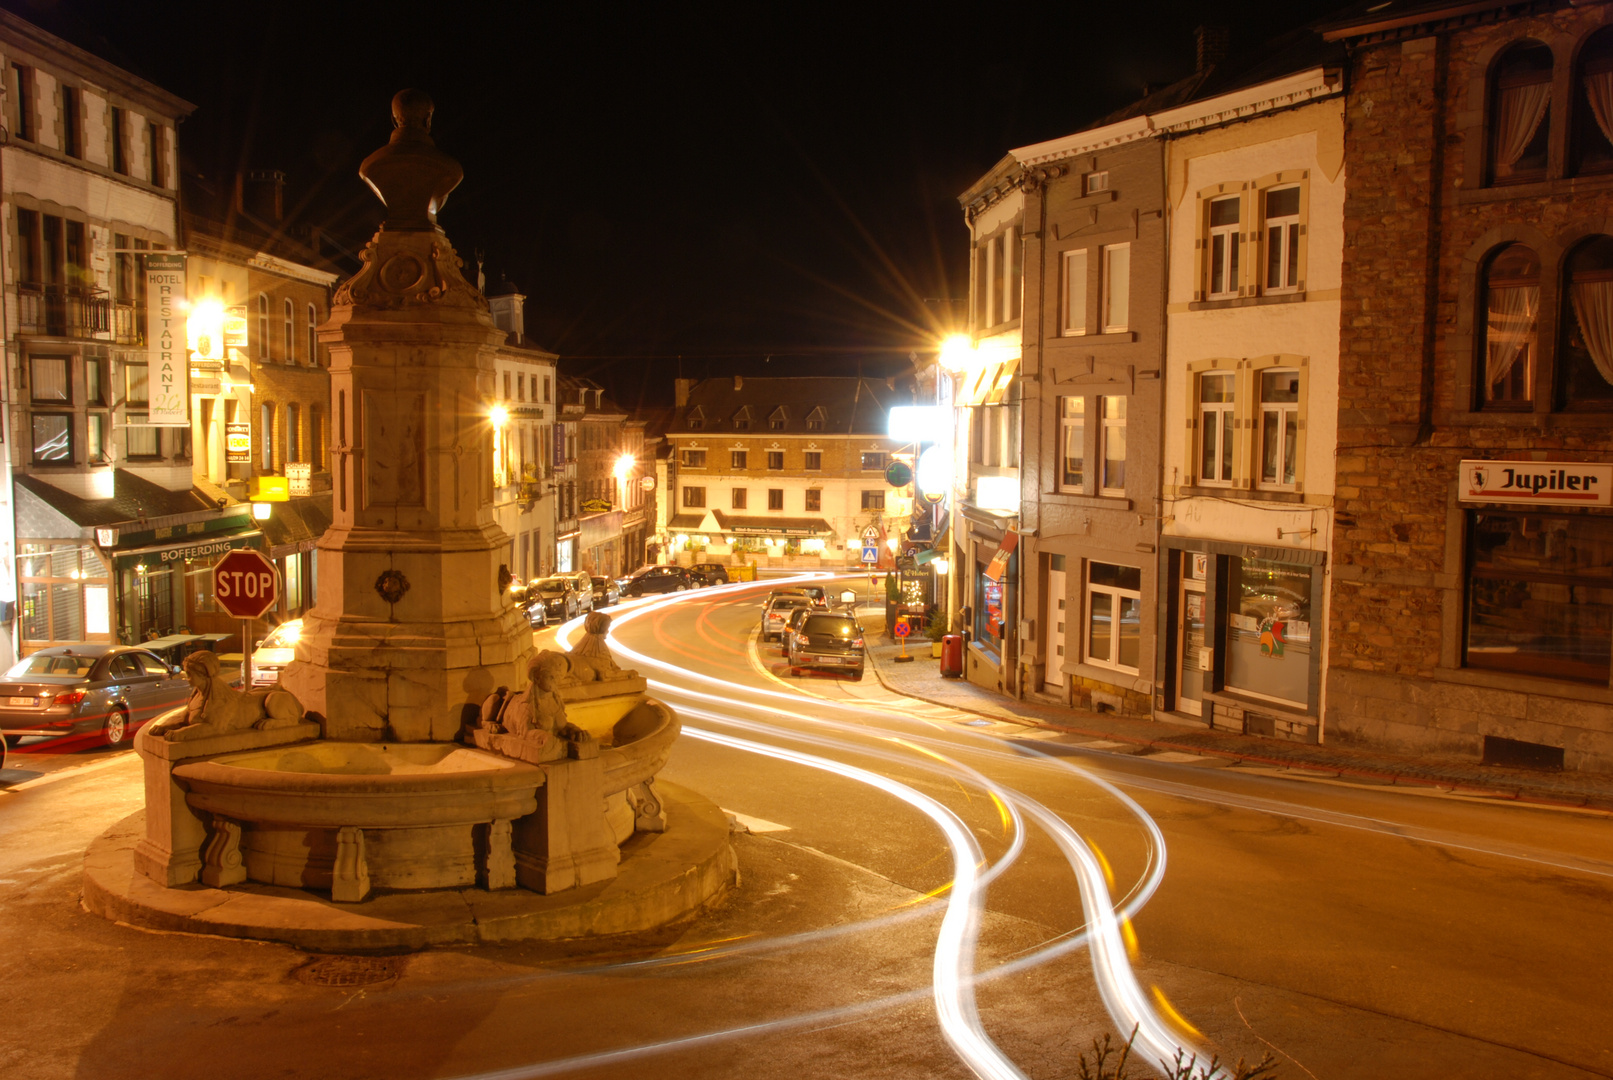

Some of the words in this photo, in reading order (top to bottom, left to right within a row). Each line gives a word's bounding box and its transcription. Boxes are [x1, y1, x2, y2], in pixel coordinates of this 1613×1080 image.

[149, 275, 181, 284] HOTEL
[160, 286, 173, 393] RESTAURANT
[1501, 468, 1599, 495] Jupiler
[160, 542, 232, 562] BOFFERDING
[218, 570, 273, 598] STOP
